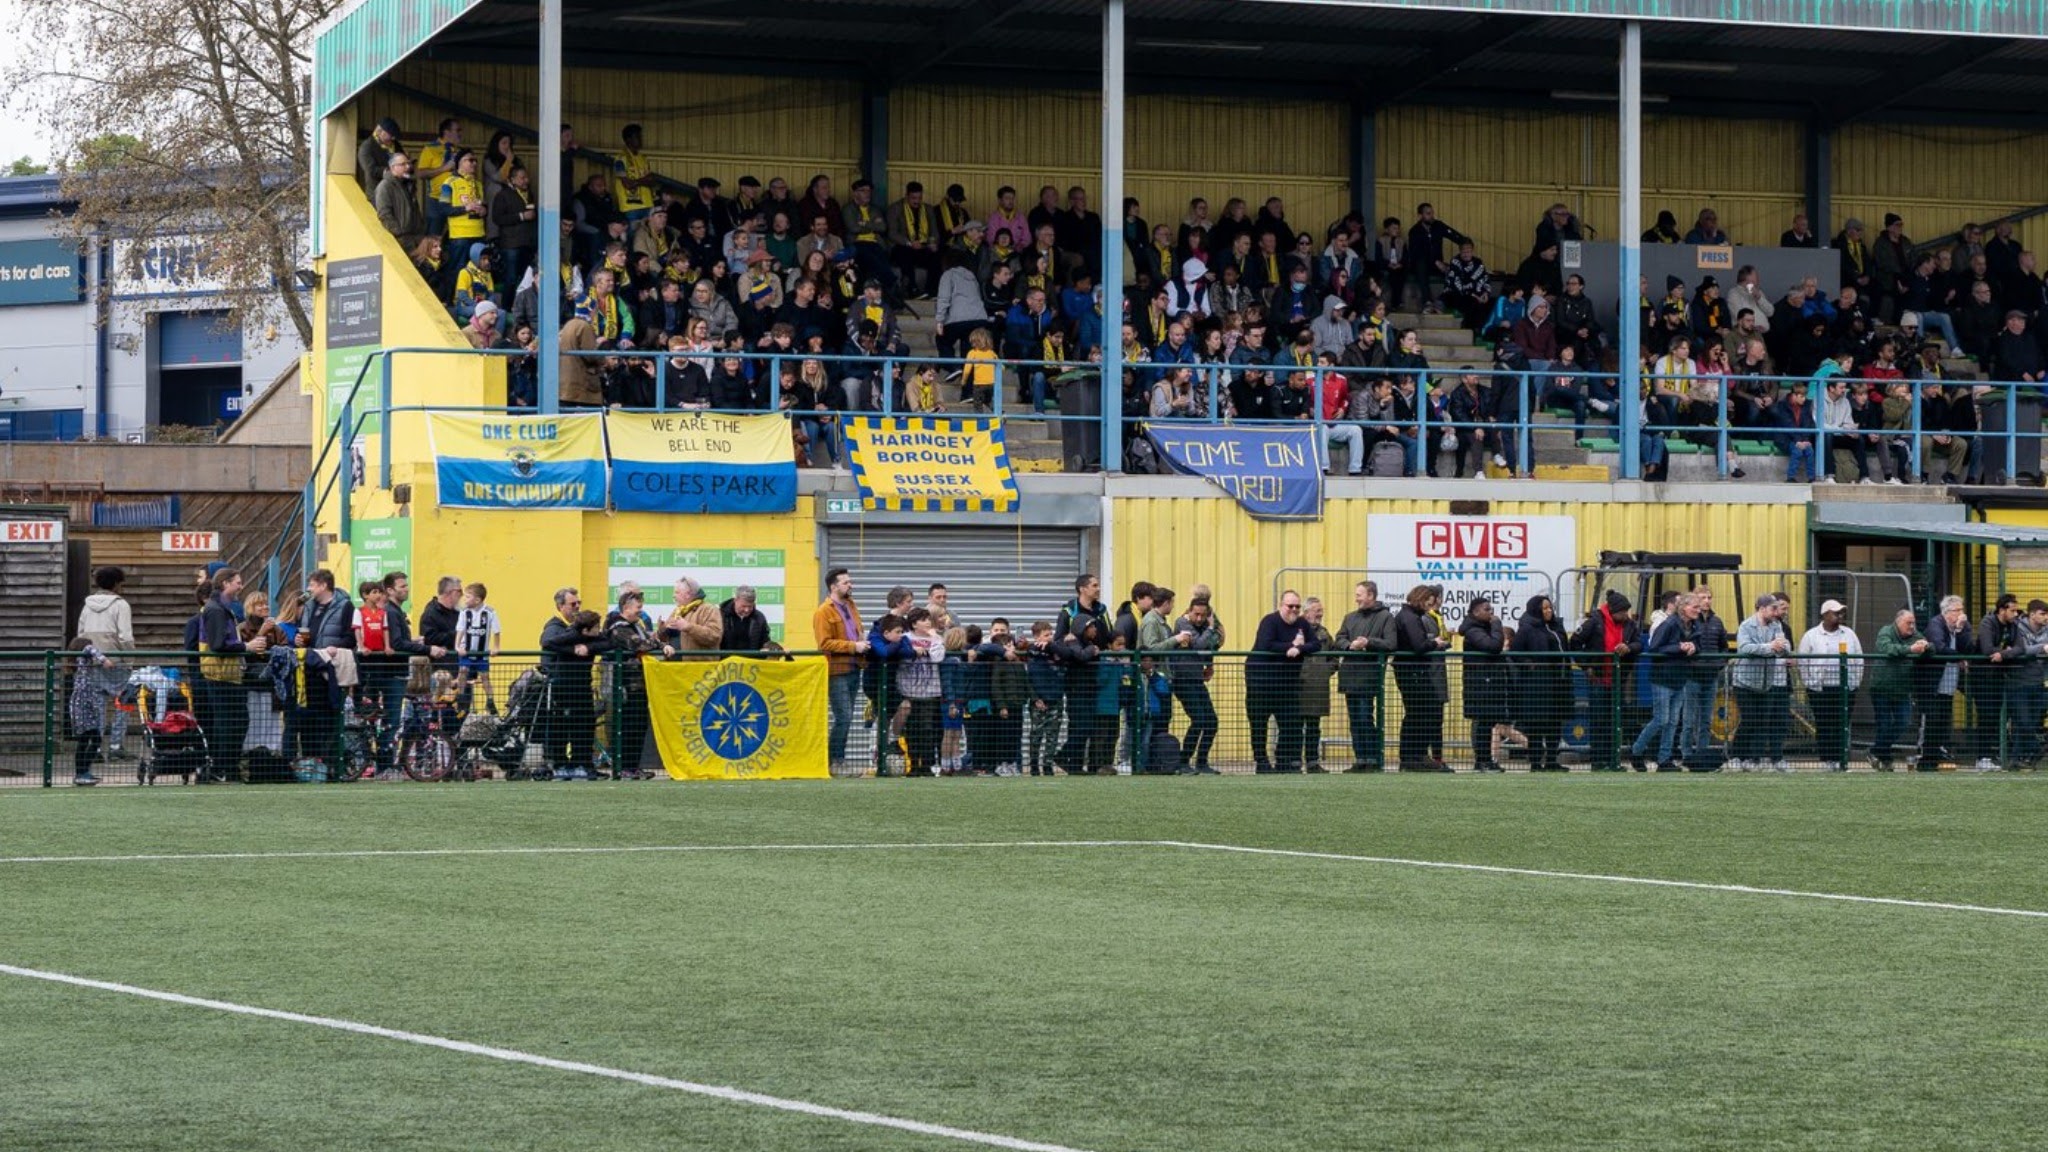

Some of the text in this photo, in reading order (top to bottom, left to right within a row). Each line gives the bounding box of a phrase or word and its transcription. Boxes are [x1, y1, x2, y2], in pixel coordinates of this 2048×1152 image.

[1701, 252, 1728, 262] PRESS
[12, 265, 27, 280] for
[29, 264, 43, 279] all
[46, 265, 70, 278] cars
[482, 424, 558, 440] ONE CLUB
[651, 417, 741, 433] WE ARE THE
[669, 439, 732, 453] BELL END
[871, 433, 973, 448] HARINGEY
[877, 450, 975, 465] BOROUGH
[1264, 442, 1305, 467] ON
[628, 471, 777, 496] COLES PARK
[894, 474, 972, 485] SUSSEX
[464, 481, 586, 501] ONE COMMUNITY
[7, 523, 53, 540] EXIT
[170, 533, 212, 549] EXIT
[1419, 524, 1525, 556] CVS
[1416, 561, 1528, 581] VAN HIRE
[1444, 590, 1511, 604] ARINGEY
[685, 662, 760, 707] CASUALS
